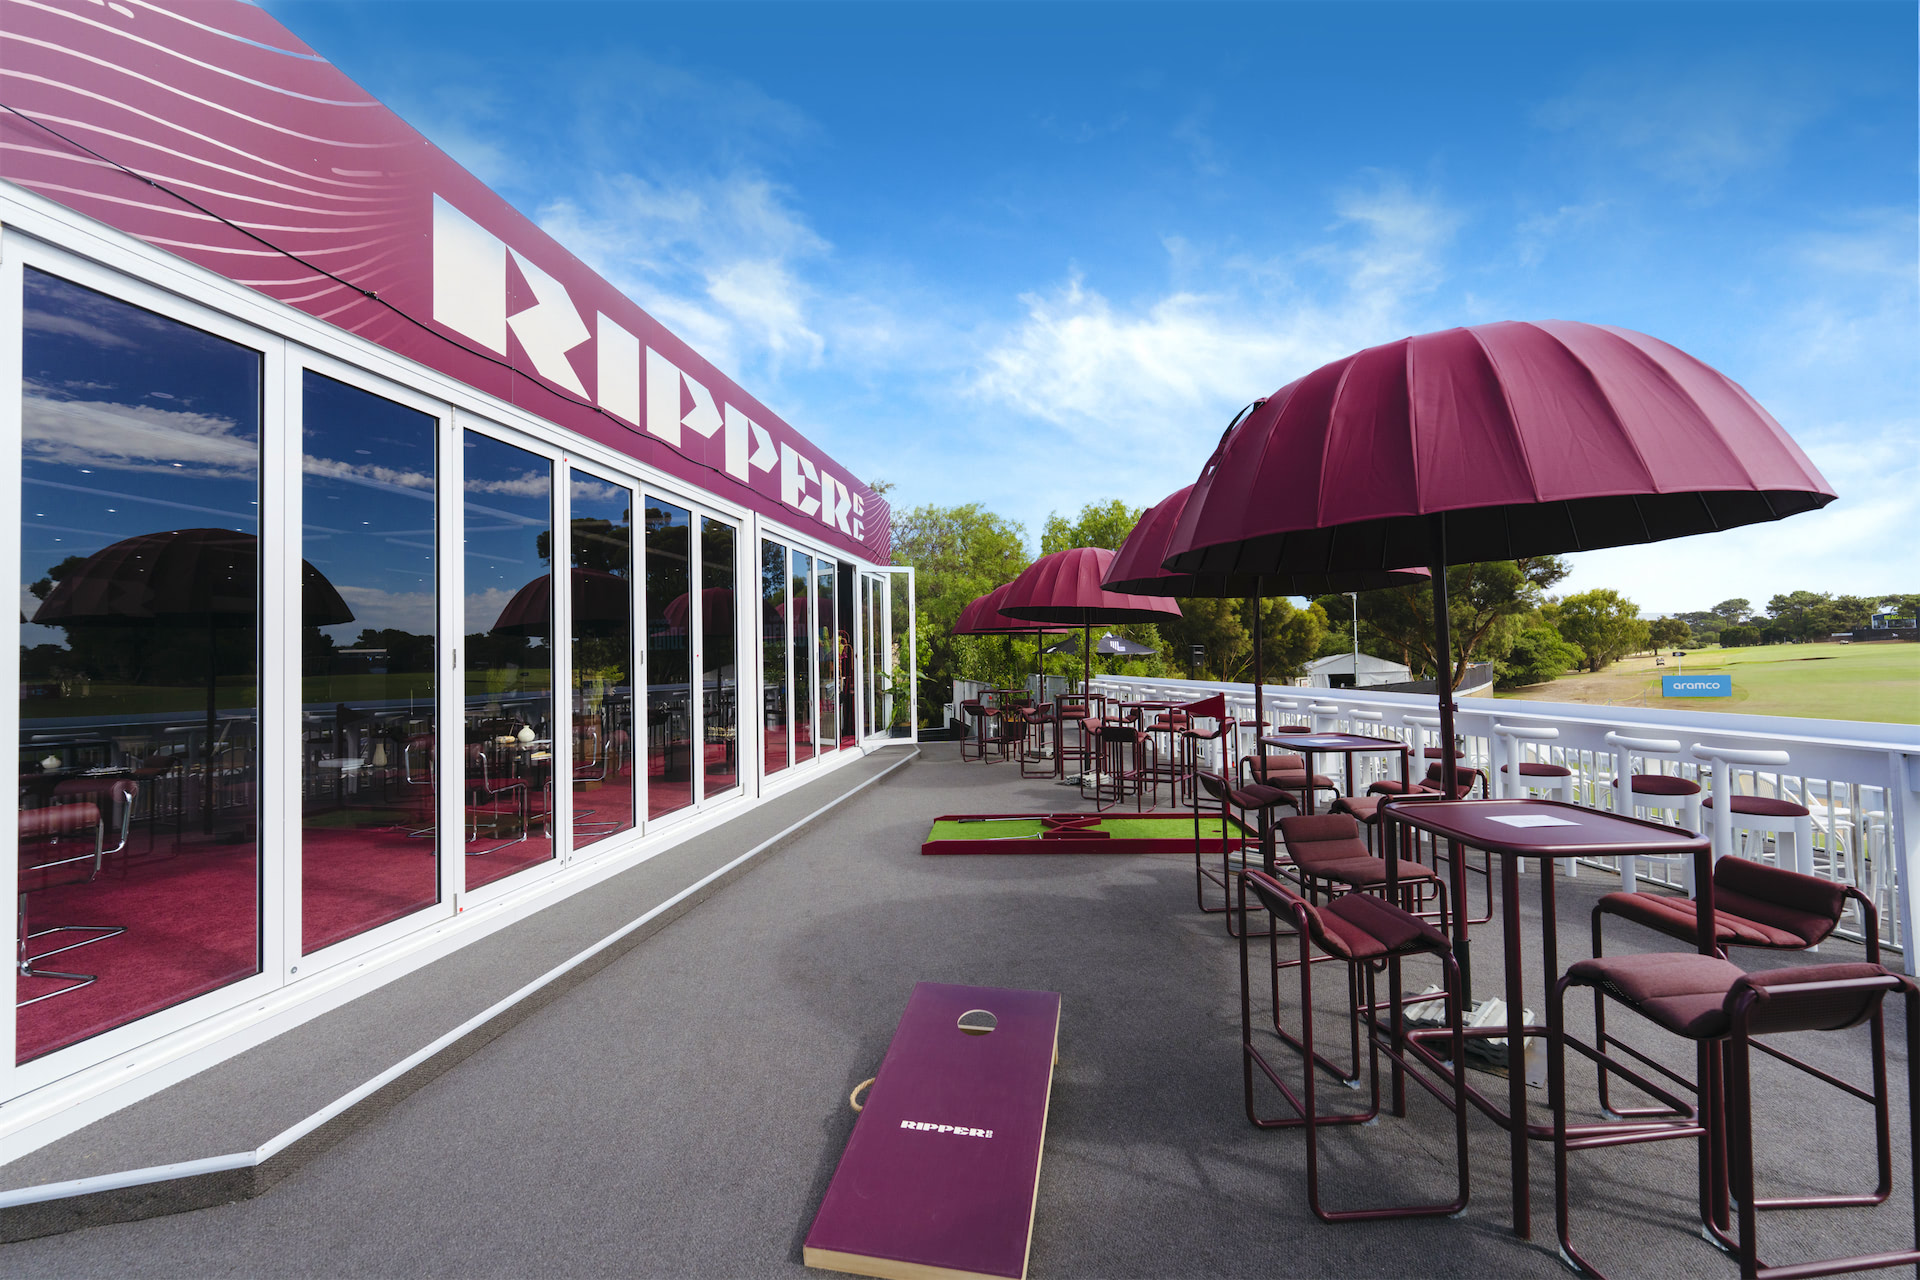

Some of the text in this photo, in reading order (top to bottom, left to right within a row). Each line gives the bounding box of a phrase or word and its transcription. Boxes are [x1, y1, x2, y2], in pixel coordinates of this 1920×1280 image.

[433, 193, 853, 537] RIPPER
[1673, 682, 1721, 690] aramco
[900, 1120, 985, 1138] RIPPER
